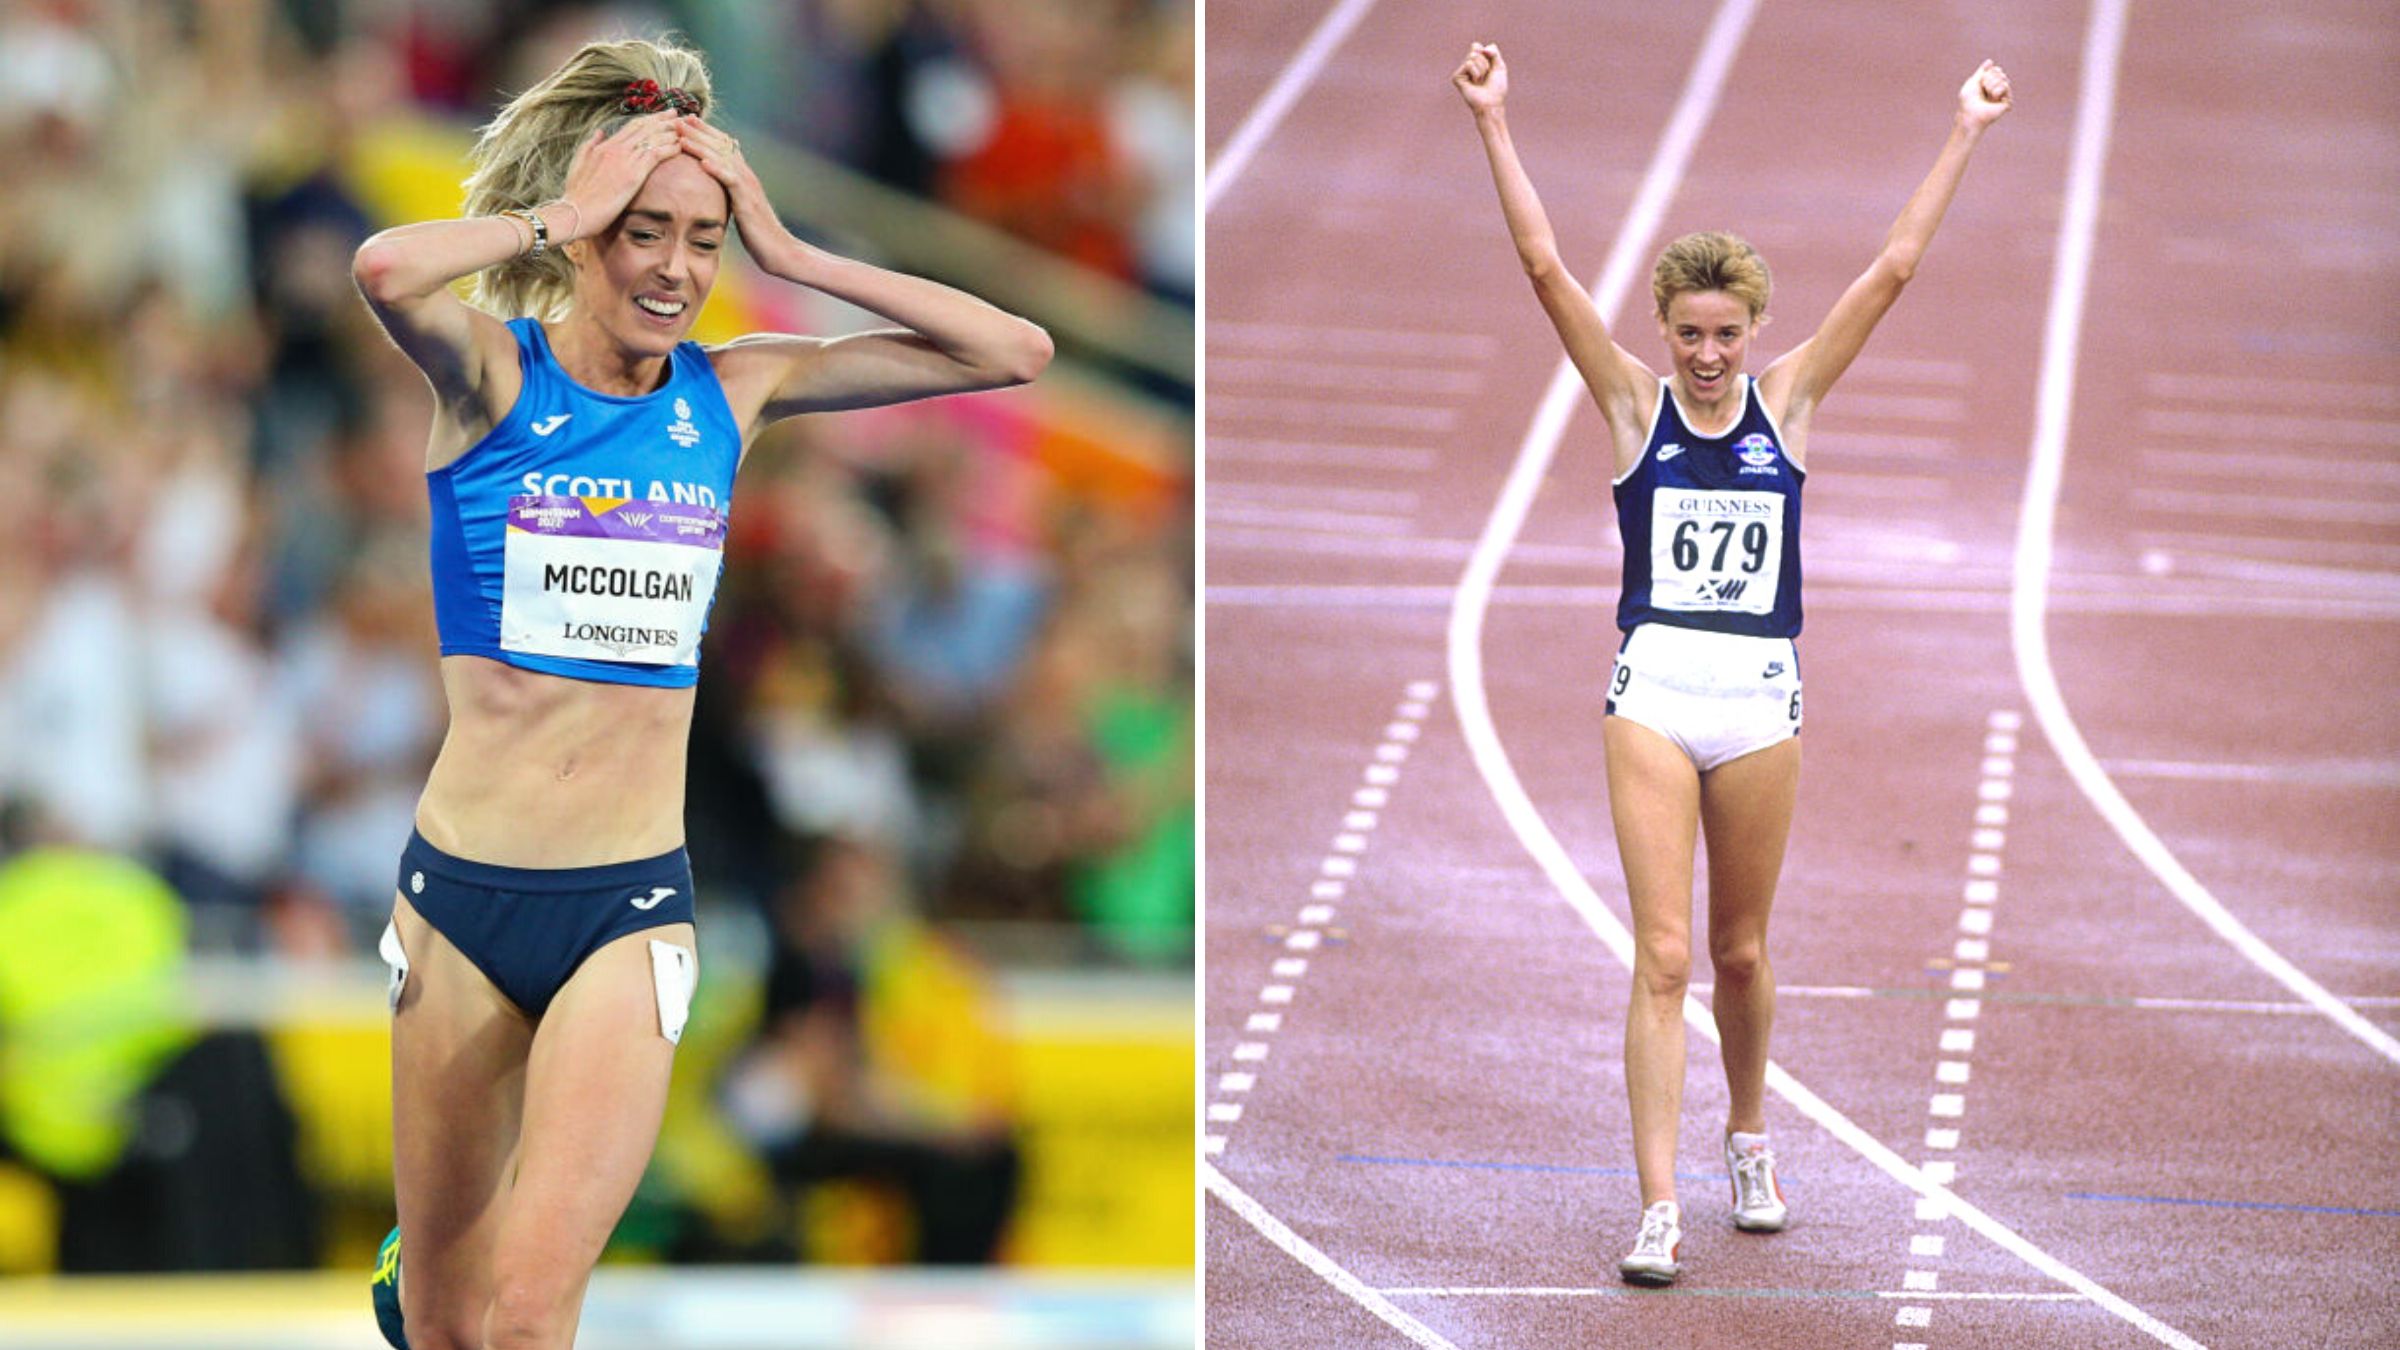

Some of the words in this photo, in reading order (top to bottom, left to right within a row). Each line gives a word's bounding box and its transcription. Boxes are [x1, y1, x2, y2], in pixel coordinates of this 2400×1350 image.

[1679, 498, 1771, 514] GUINNESS
[1672, 520, 1769, 574] 679
[544, 564, 694, 602] MCCOLGAN
[563, 622, 679, 646] LONGINES
[1614, 660, 1631, 696] 9
